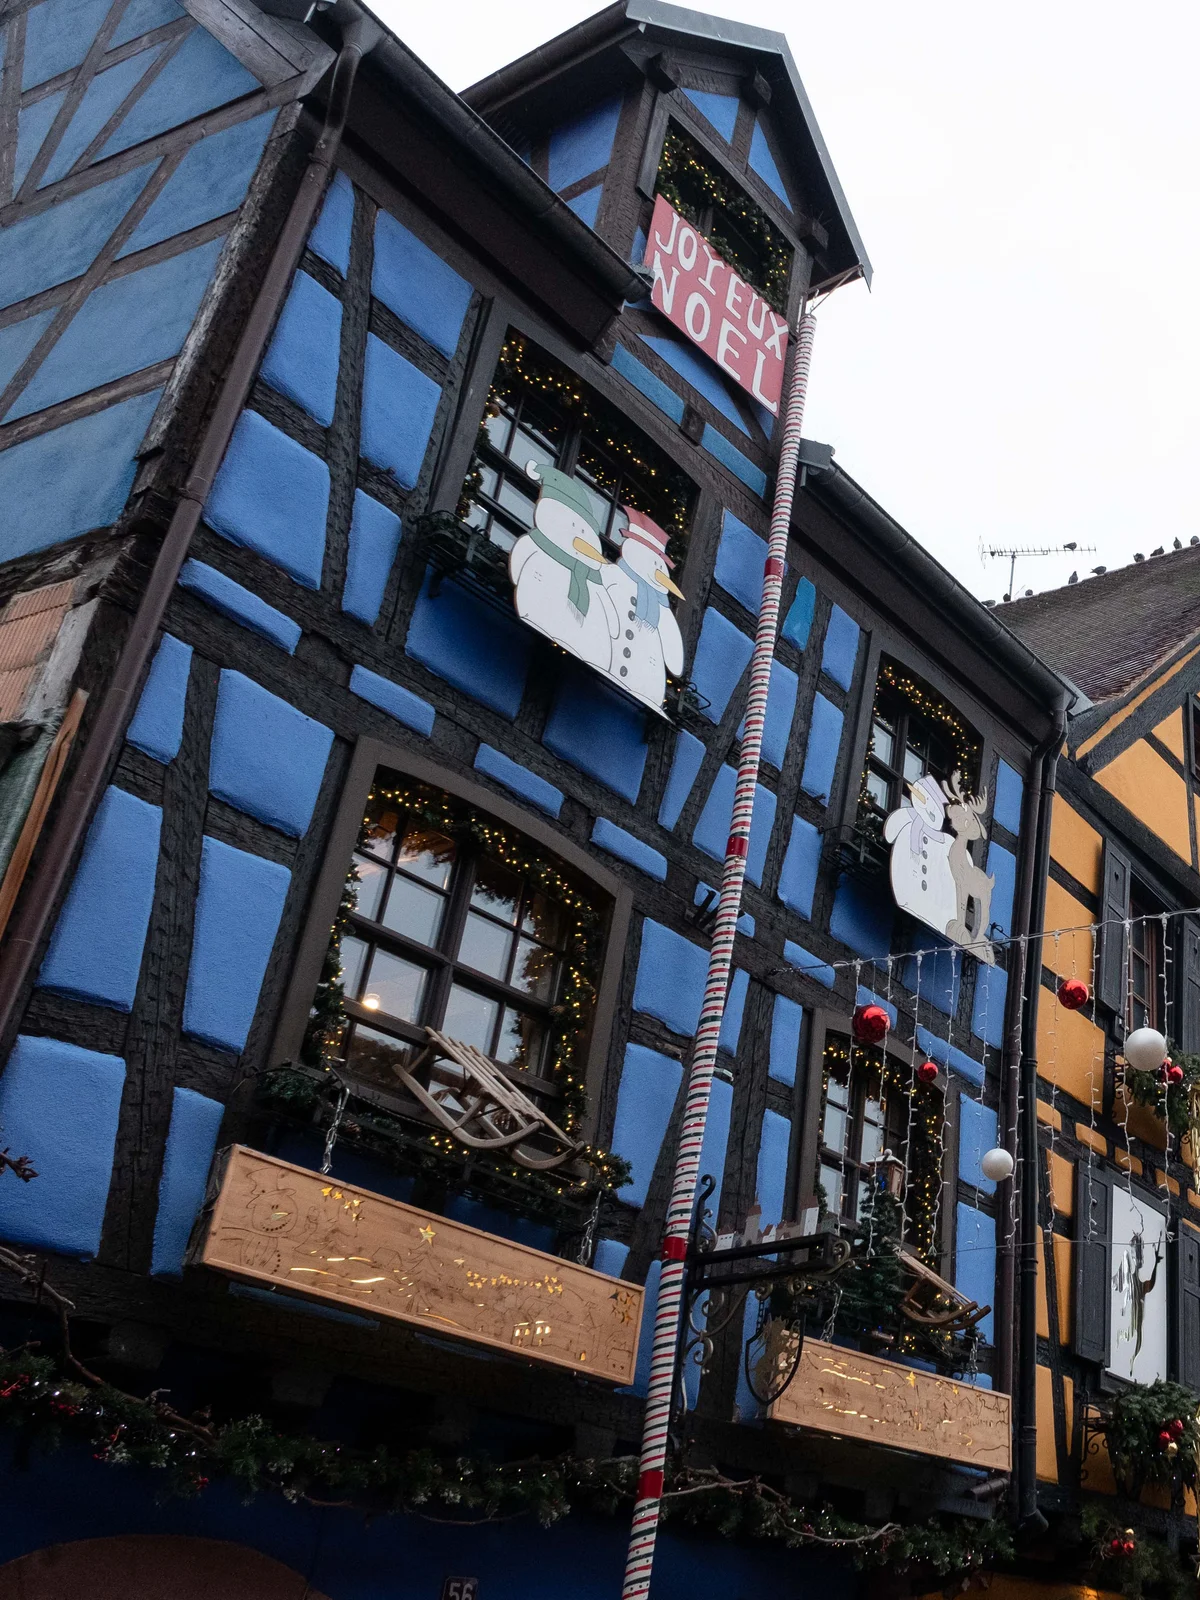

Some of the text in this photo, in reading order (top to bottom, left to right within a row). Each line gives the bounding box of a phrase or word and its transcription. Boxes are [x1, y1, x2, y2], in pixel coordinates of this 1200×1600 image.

[650, 250, 778, 413] NOEL
[654, 211, 789, 361] JOYEUX
[449, 1582, 473, 1600] 56
